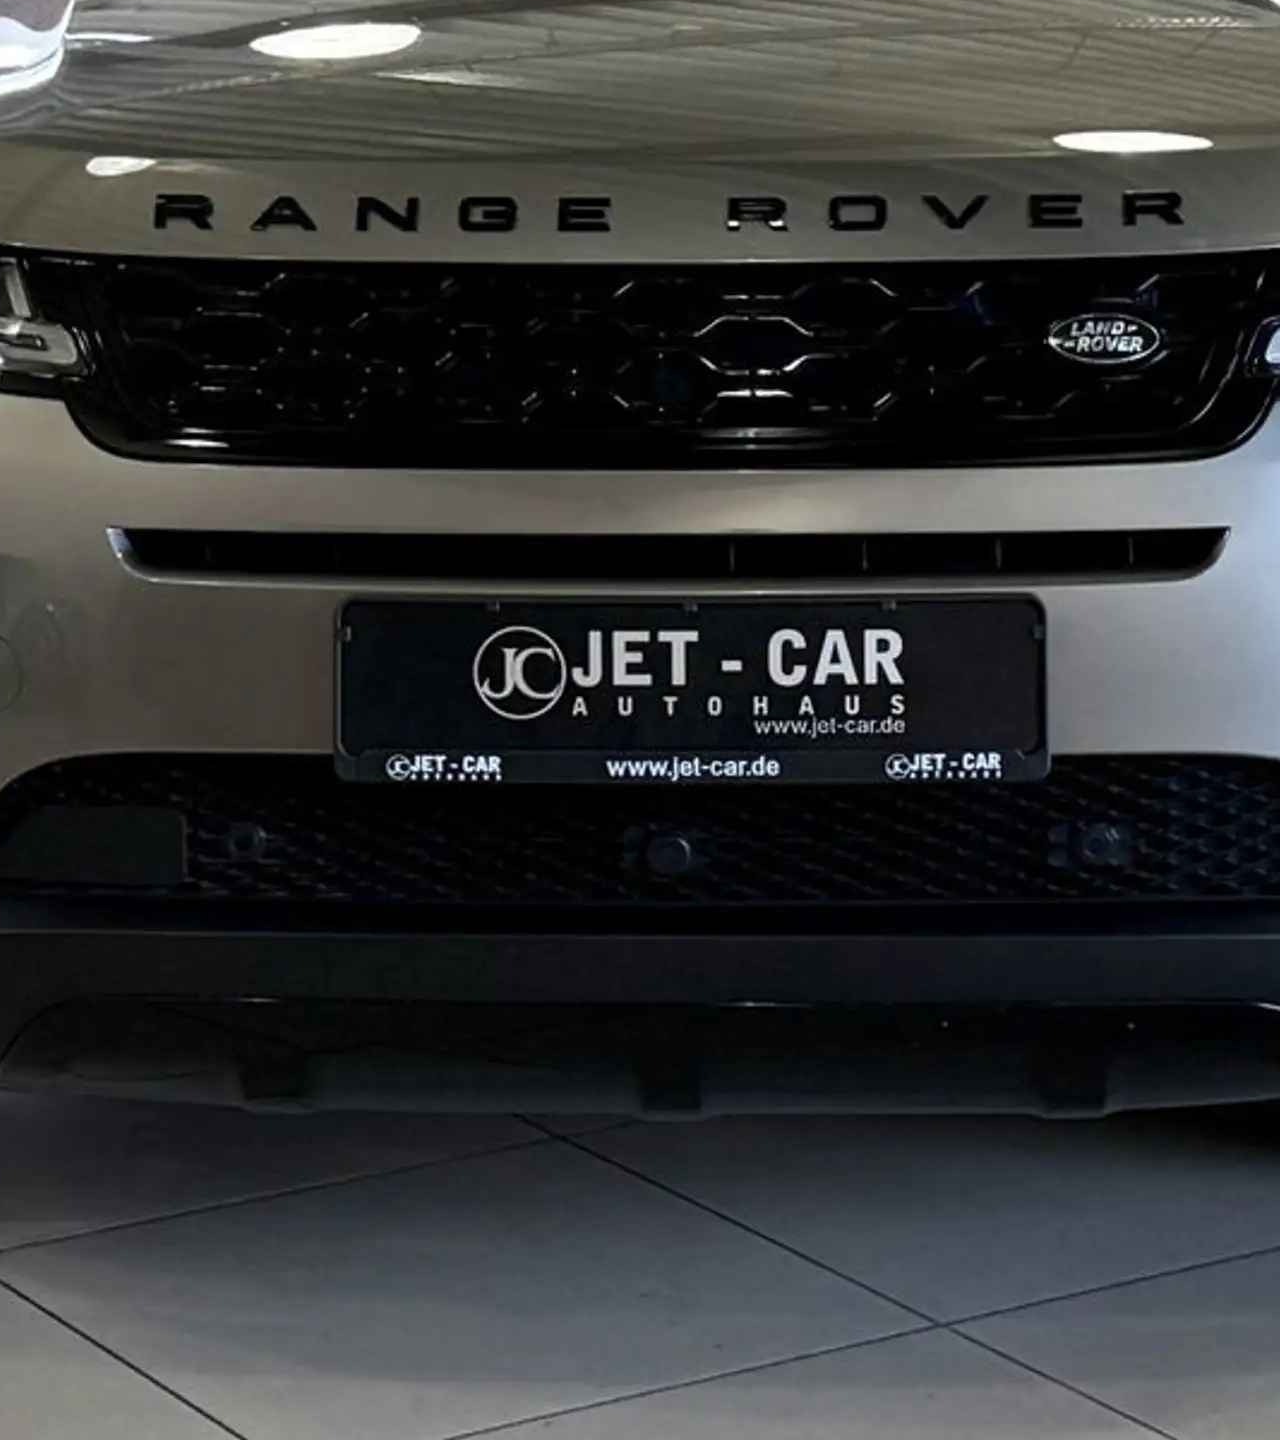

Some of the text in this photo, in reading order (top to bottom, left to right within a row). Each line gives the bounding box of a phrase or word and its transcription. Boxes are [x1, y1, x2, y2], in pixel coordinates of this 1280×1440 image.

[153, 189, 1185, 232] RANGE ROVER
[1070, 320, 1125, 337] LAND
[1076, 336, 1144, 353] ROVER
[571, 629, 700, 688] JET
[767, 628, 905, 687] CAR
[572, 694, 906, 717] AUTOHAUS
[753, 715, 906, 736] www.jet-car.de
[410, 754, 447, 773] JET
[462, 755, 502, 773] CAR
[606, 755, 781, 780] www.jet-car.de
[910, 752, 947, 771] JET
[962, 751, 1001, 771] CAR
